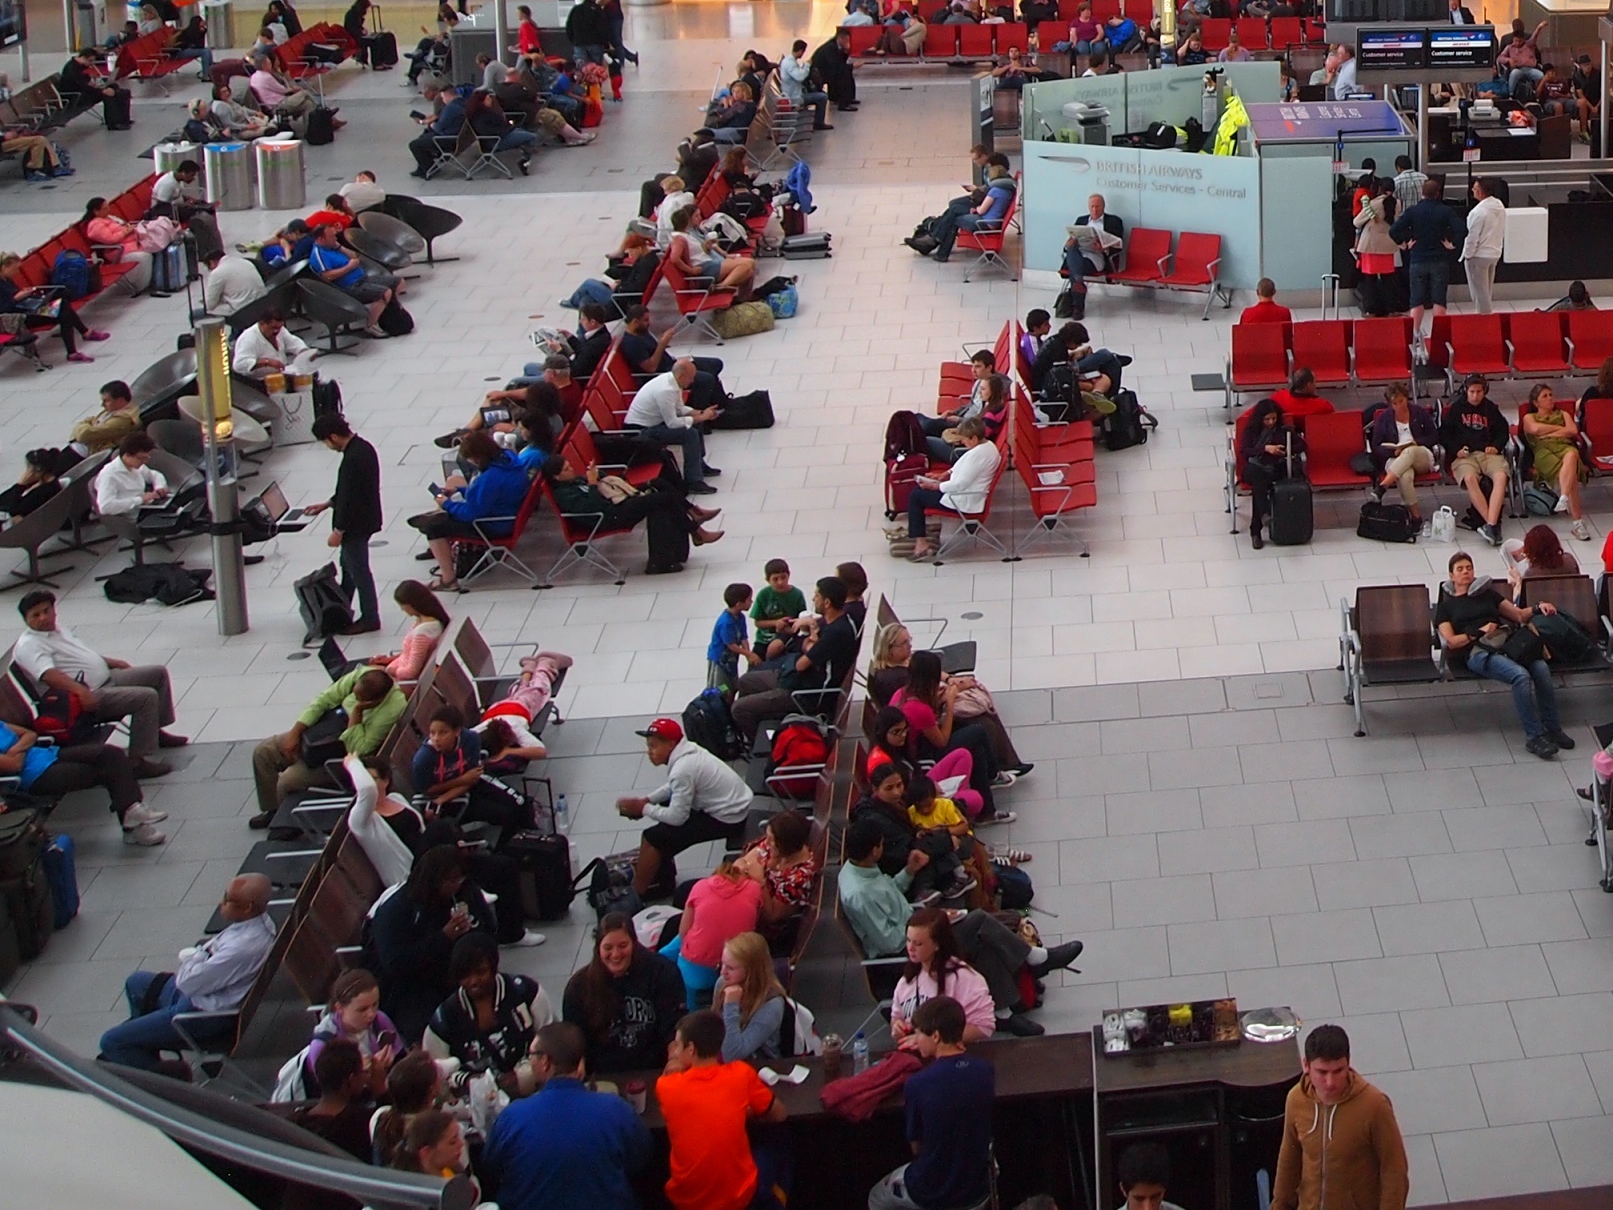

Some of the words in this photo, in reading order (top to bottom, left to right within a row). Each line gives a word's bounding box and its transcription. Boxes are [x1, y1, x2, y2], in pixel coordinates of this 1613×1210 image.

[1096, 160, 1146, 176] BRITISH
[1149, 164, 1203, 180] AIRWAYS
[1096, 177, 1147, 190] Customer
[1151, 181, 1196, 195] Services
[1207, 186, 1247, 200] Central
